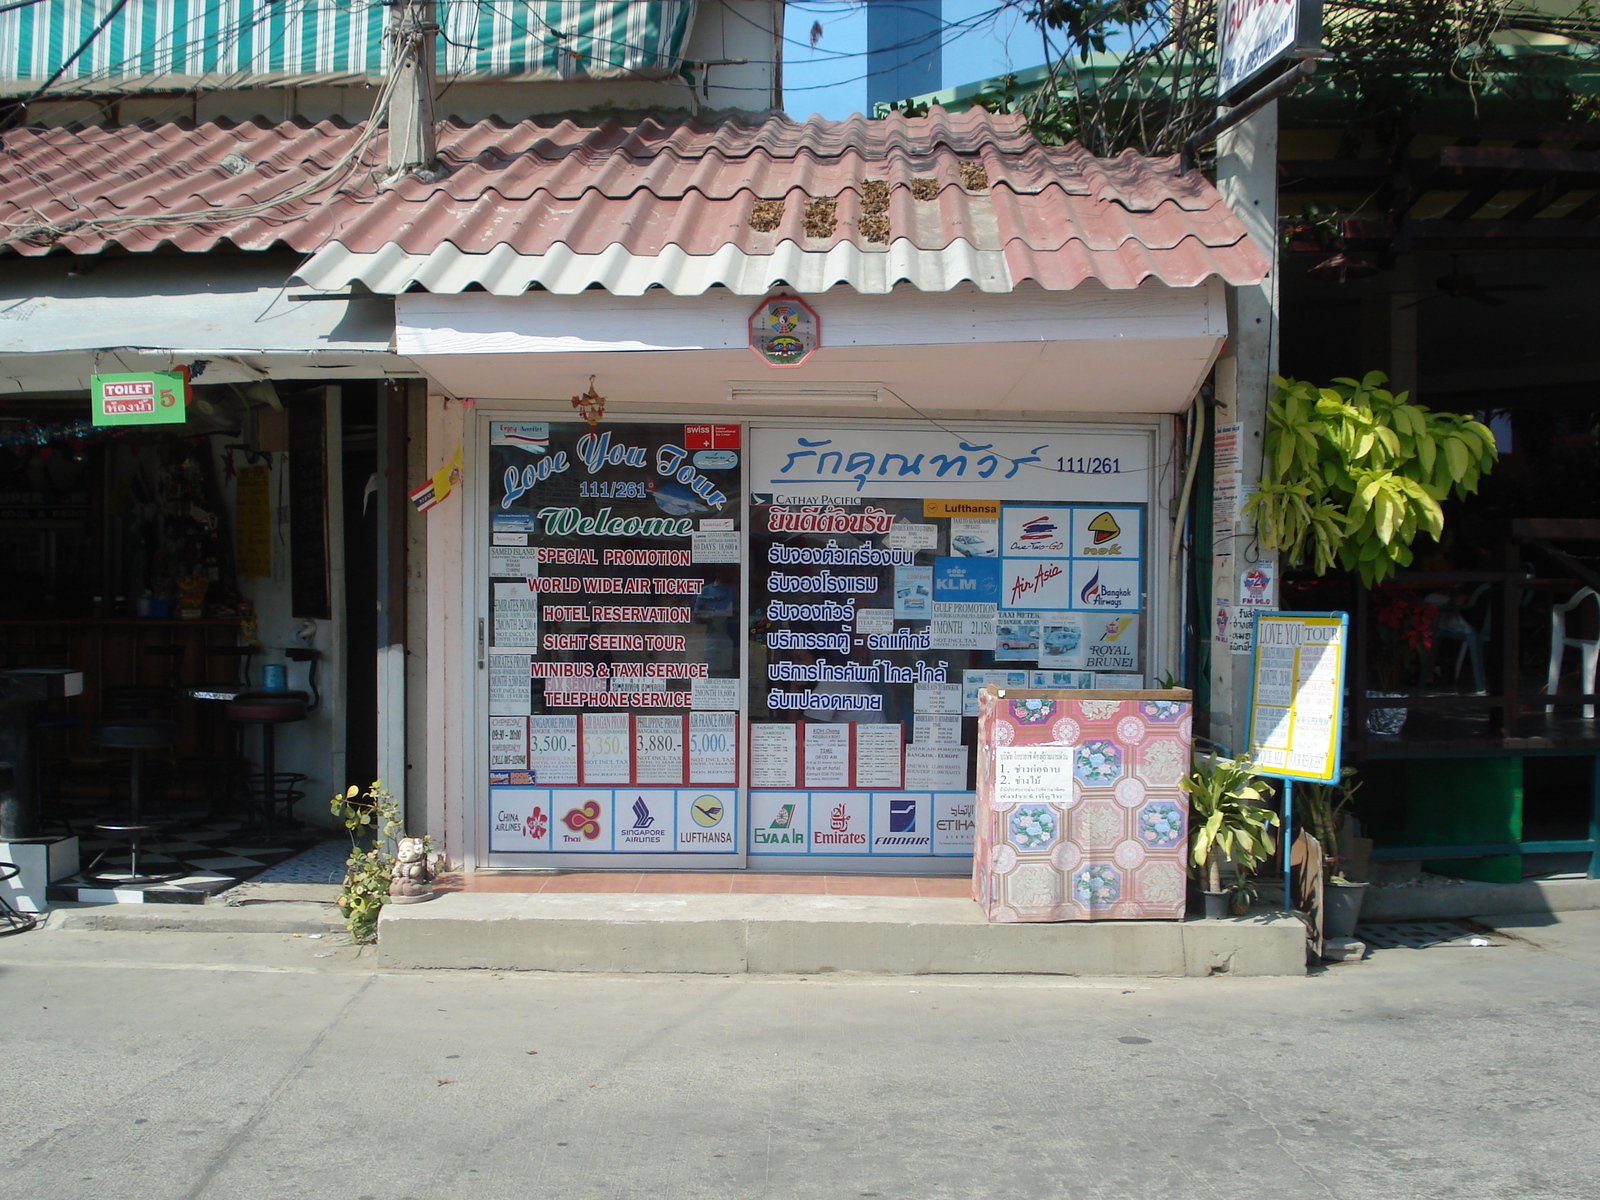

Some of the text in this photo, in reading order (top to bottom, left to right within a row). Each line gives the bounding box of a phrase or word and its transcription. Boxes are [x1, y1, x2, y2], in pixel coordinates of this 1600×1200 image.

[106, 384, 152, 395] TOILET
[160, 389, 176, 407] 5
[106, 399, 152, 412] ห้องน้ำ
[501, 430, 728, 512] Love You Tour
[780, 437, 1121, 492] รักคุณทัวร์ 111/261
[580, 481, 646, 498] 111/261
[0, 492, 43, 503] UPER
[776, 495, 860, 505] CATHAY PACIFIC
[945, 504, 996, 514] Lufthansa
[537, 506, 695, 537] Welcome
[768, 506, 896, 532] ยินดีต้อนรับ
[768, 539, 914, 566] รับจองตั๋วเครื่องบิน
[1010, 542, 1064, 550] One-Two-GO
[1083, 544, 1122, 555] nok
[538, 548, 598, 565] SPECIAL
[603, 549, 691, 566] PROMOTION
[527, 577, 704, 595] WORLD WIDE AIR TICKET
[768, 570, 878, 593] รับจองโรงแรม
[936, 578, 977, 590] KLM
[1011, 563, 1062, 604] Air Asia
[1101, 585, 1132, 598] Bangkok
[934, 604, 995, 612] GULF PROMOTION
[1093, 596, 1122, 608] Airways
[543, 605, 691, 623] HOTEL RESERVATION
[768, 598, 855, 622] รับจองทัวร์
[768, 625, 932, 654] บริการรถตู้ - รถแท็กซี่
[1260, 624, 1284, 644] LOVE
[1285, 624, 1304, 645] YOU
[1305, 627, 1339, 641] TOUR
[543, 633, 686, 651] SIGHT SEEING TOUR
[1090, 645, 1130, 657] ROYAL
[1086, 658, 1133, 667] BRUNEI
[530, 662, 708, 680] MINIBUS & TAXI SERVICE
[768, 660, 948, 684] บริการโทรศัพท์ ไกล-ใกล้
[546, 679, 565, 692] FAX
[567, 679, 606, 692] SERVICE
[545, 692, 630, 707] TELEPHONE
[630, 692, 692, 708] SERVICE
[768, 690, 882, 711] รับแปลจดหมาย
[492, 718, 521, 728] OPEN
[531, 717, 576, 728] SINGAPORE PROMO
[584, 716, 592, 729] AIR
[611, 716, 628, 729] PROMO
[637, 718, 681, 728] PHILIPPINE PROMO
[690, 714, 699, 727] AIR
[700, 714, 718, 727] FRANCE
[530, 736, 576, 754] 3,500.-
[584, 736, 628, 758] 5,350.-
[636, 736, 681, 754] 3,880.-
[690, 734, 734, 755] 5,000.-
[1000, 764, 1010, 773] 1.
[1000, 775, 1042, 784] 2. ช่างไม้
[497, 810, 519, 822] CHINA
[495, 823, 521, 833] AIRLINES
[936, 820, 975, 830] ETIHA
[680, 832, 732, 843] LUFTHANSA
[814, 832, 866, 844] Emirates
[875, 836, 929, 845] FINNAIR
